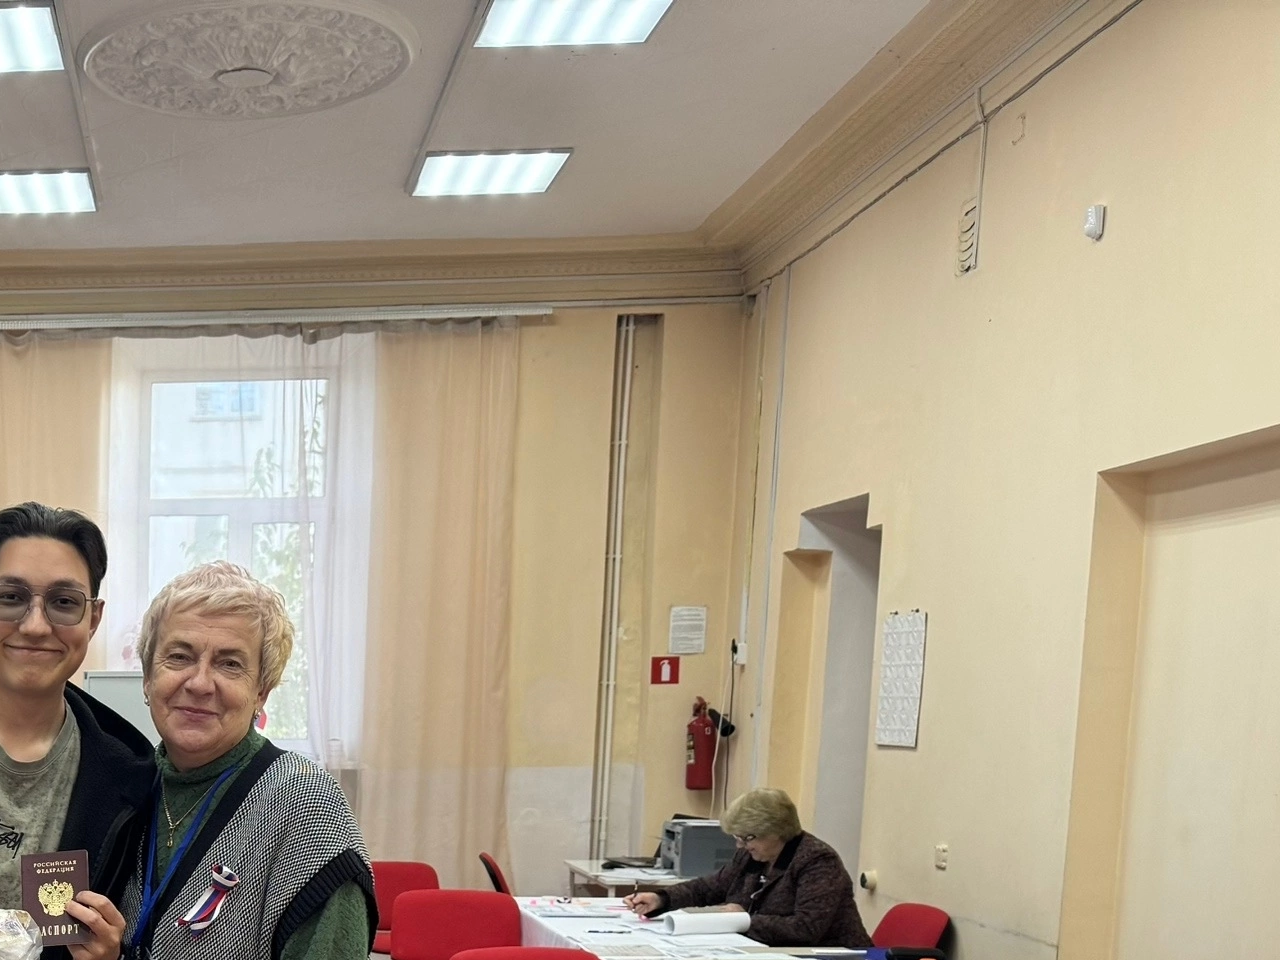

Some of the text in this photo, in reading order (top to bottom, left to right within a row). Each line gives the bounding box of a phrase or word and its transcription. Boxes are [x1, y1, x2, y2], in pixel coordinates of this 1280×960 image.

[33, 860, 77, 868] РОССИЙСКАЯ
[36, 866, 74, 874] ФЕДЕРАЦИЯ
[41, 924, 80, 937] АСПОРТ
